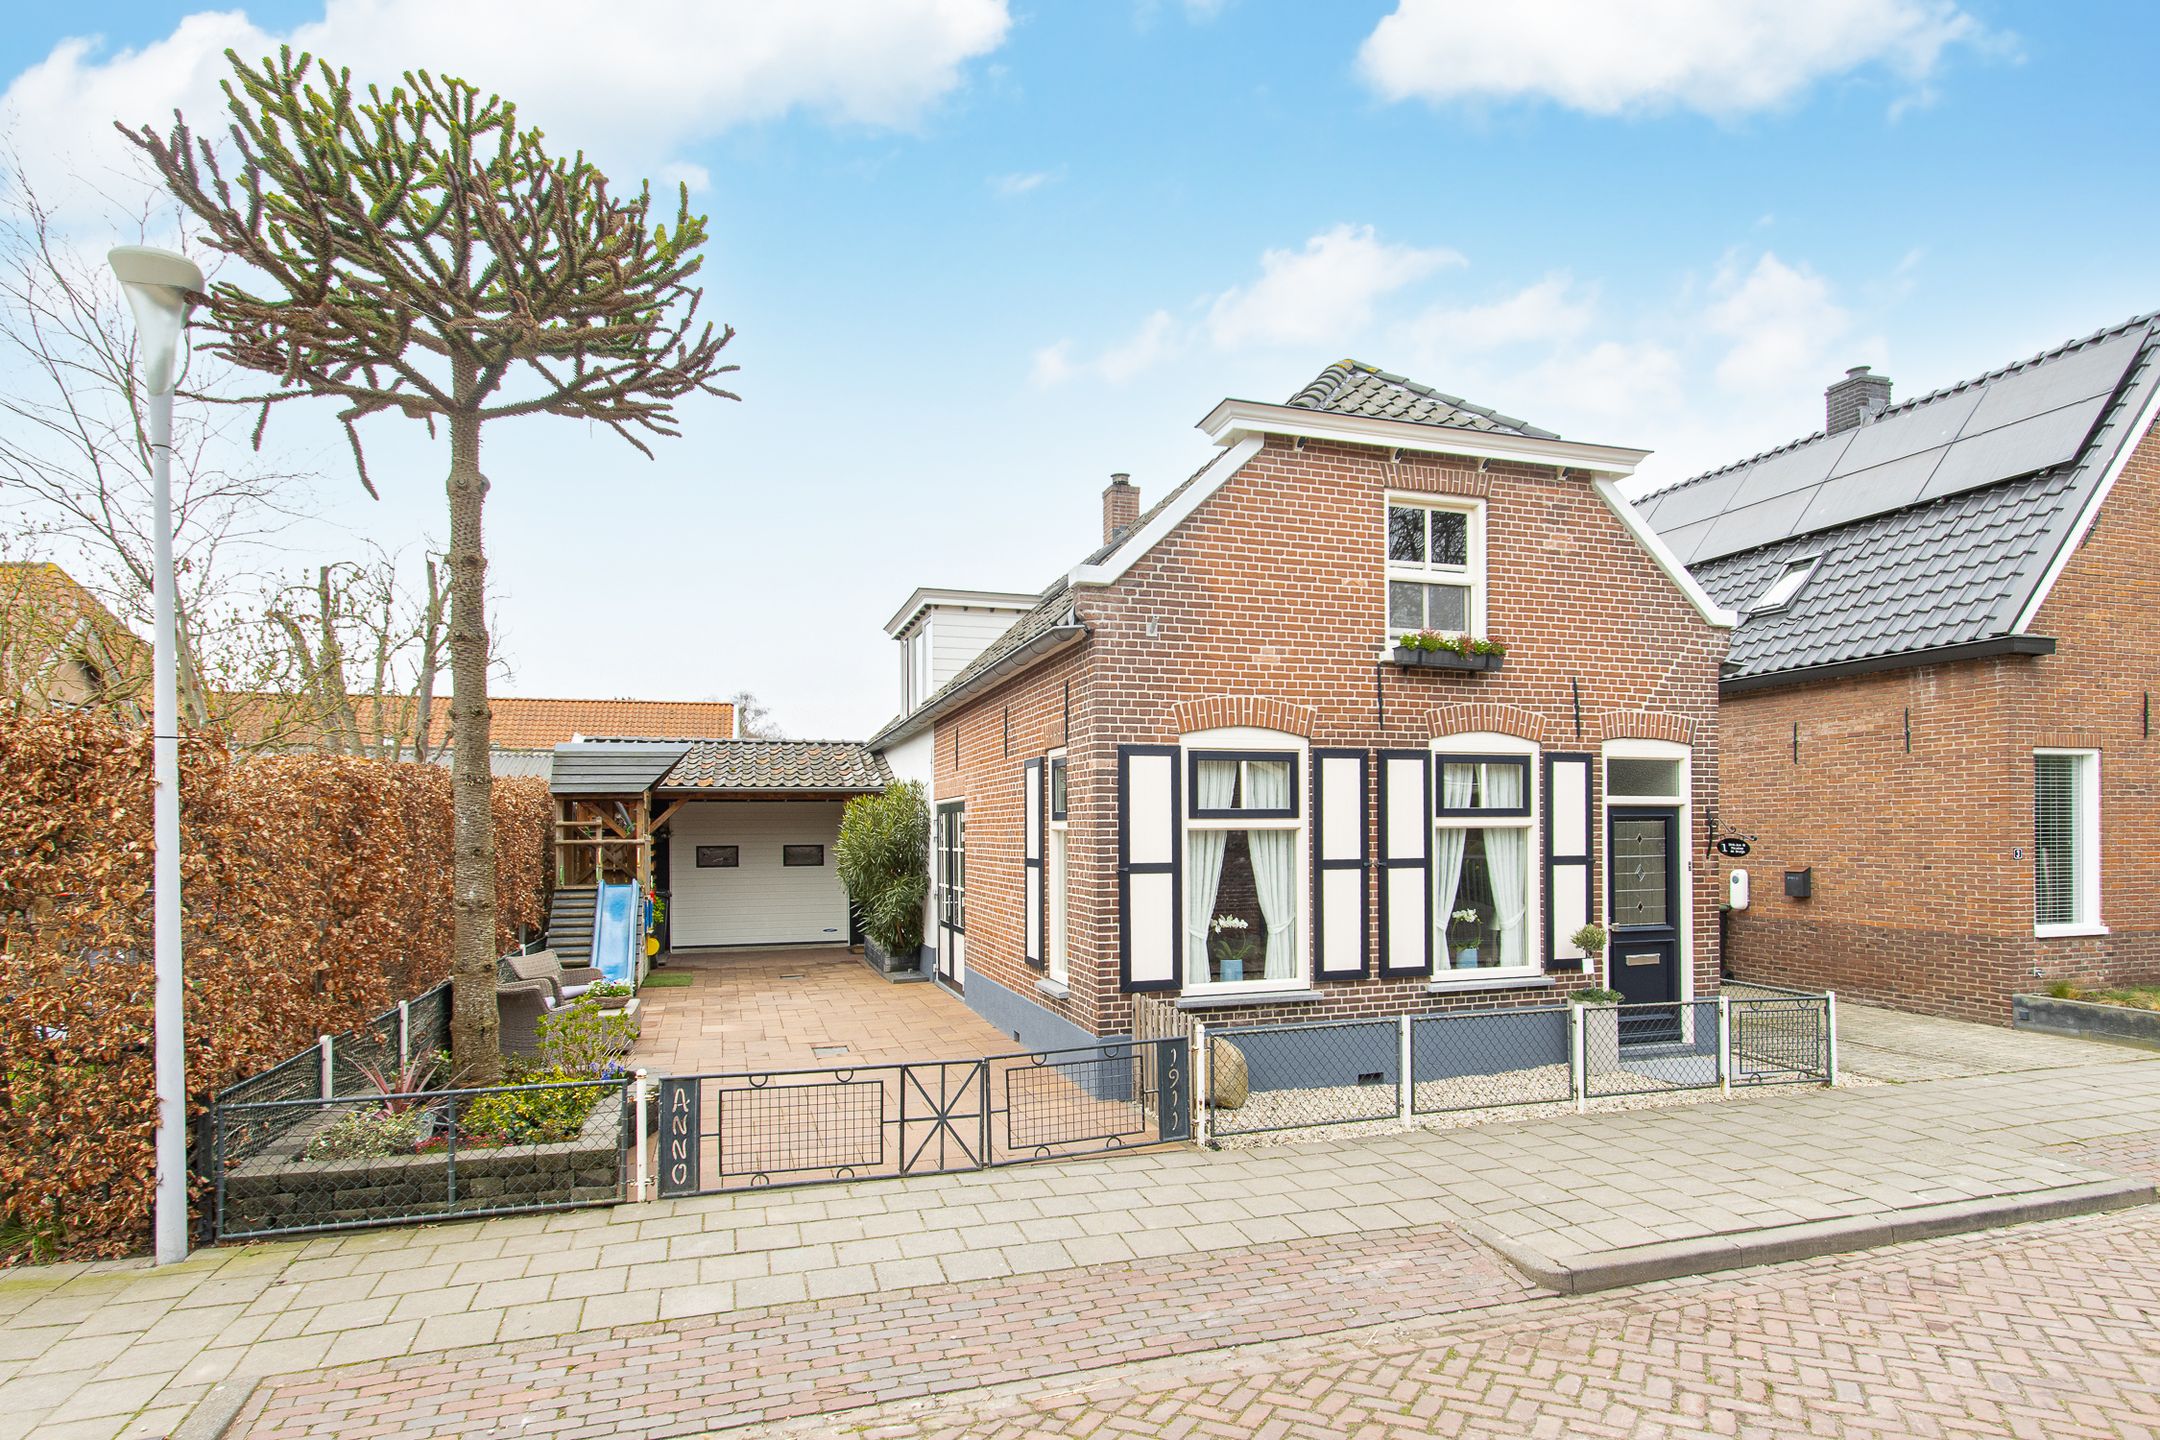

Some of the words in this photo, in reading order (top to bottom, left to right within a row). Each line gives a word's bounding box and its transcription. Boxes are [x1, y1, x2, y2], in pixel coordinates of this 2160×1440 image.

[1720, 843, 1728, 852] 1
[1168, 1048, 1179, 1131] 1911
[671, 1087, 690, 1185] ANNO
